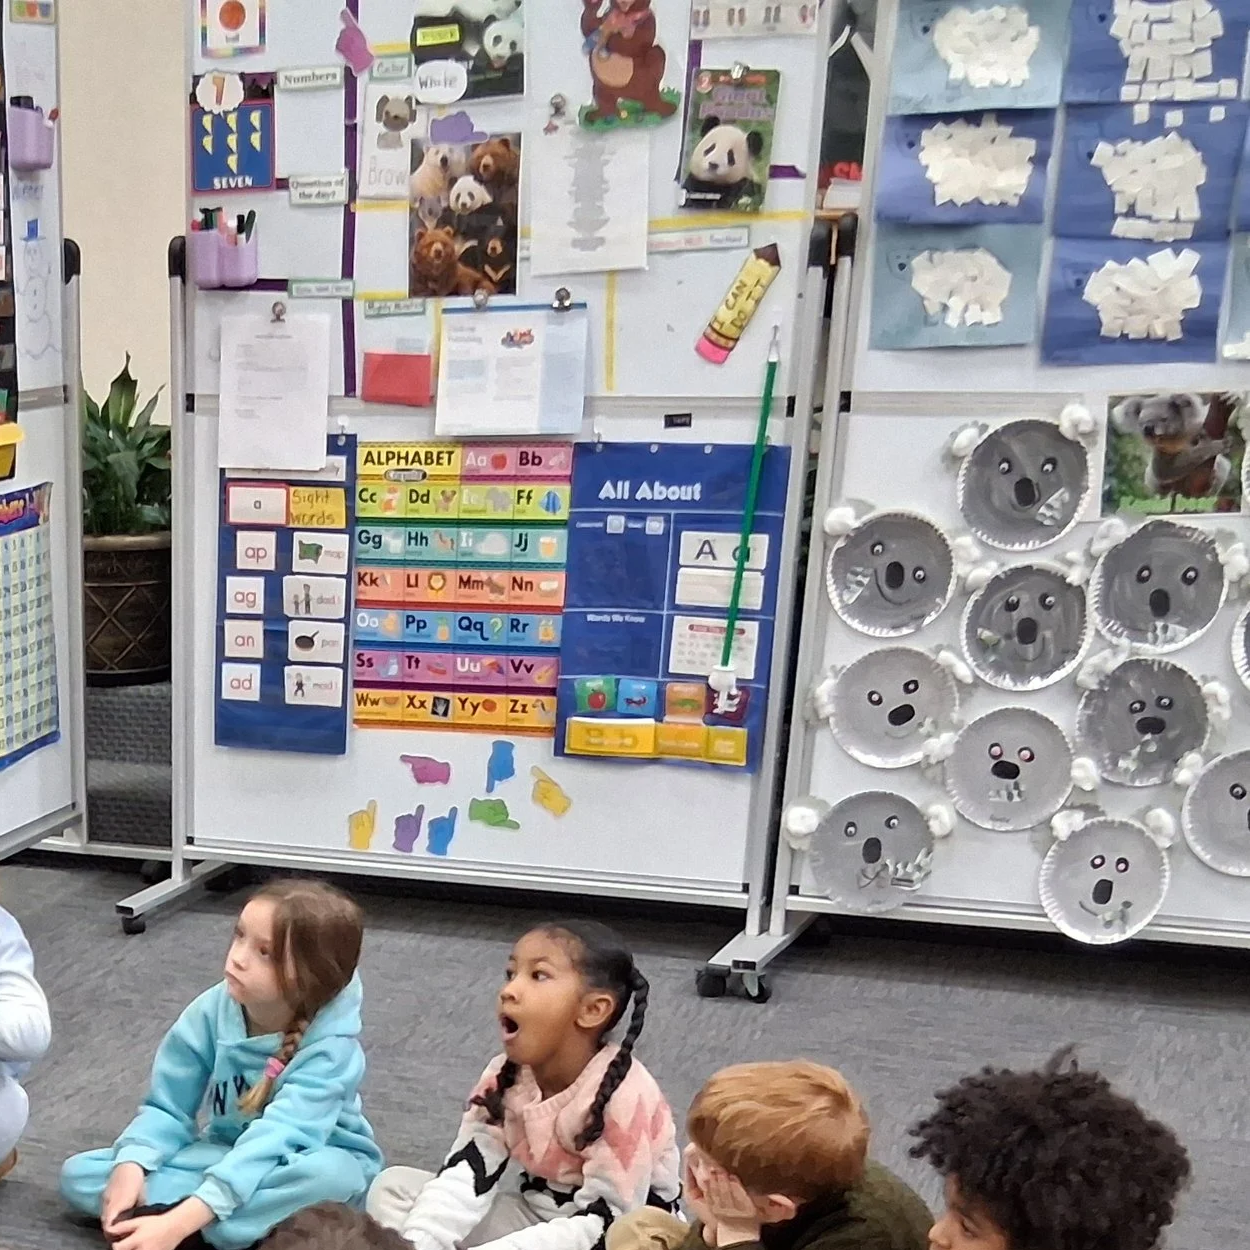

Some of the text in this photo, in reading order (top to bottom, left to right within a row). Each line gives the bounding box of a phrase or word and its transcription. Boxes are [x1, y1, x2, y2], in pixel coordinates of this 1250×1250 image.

[284, 71, 337, 86] Numbers
[213, 176, 253, 190] SEVEN
[299, 191, 314, 199] the
[725, 279, 747, 311] CAN
[730, 310, 747, 330] DO
[363, 450, 543, 467] ALPHABET Aa Bb
[292, 489, 330, 508] Sight
[358, 488, 377, 504] Cc
[409, 489, 430, 505] Dd
[516, 489, 533, 505] Ff
[598, 480, 702, 501] All About
[254, 500, 262, 510] a
[358, 530, 382, 550] Gg
[407, 531, 429, 547] Hh
[514, 533, 528, 551] Jj
[245, 547, 267, 564] ap
[695, 539, 717, 561] A
[357, 572, 534, 591] Kk Ll Mm Nn
[234, 591, 256, 608] ag
[356, 612, 530, 641] Oo Pp Qq Rr
[235, 635, 255, 648] an
[356, 653, 534, 674] Ss Tt Uu Vv
[230, 673, 253, 691] ad
[356, 692, 529, 716] Ww Xx Yy Zz
